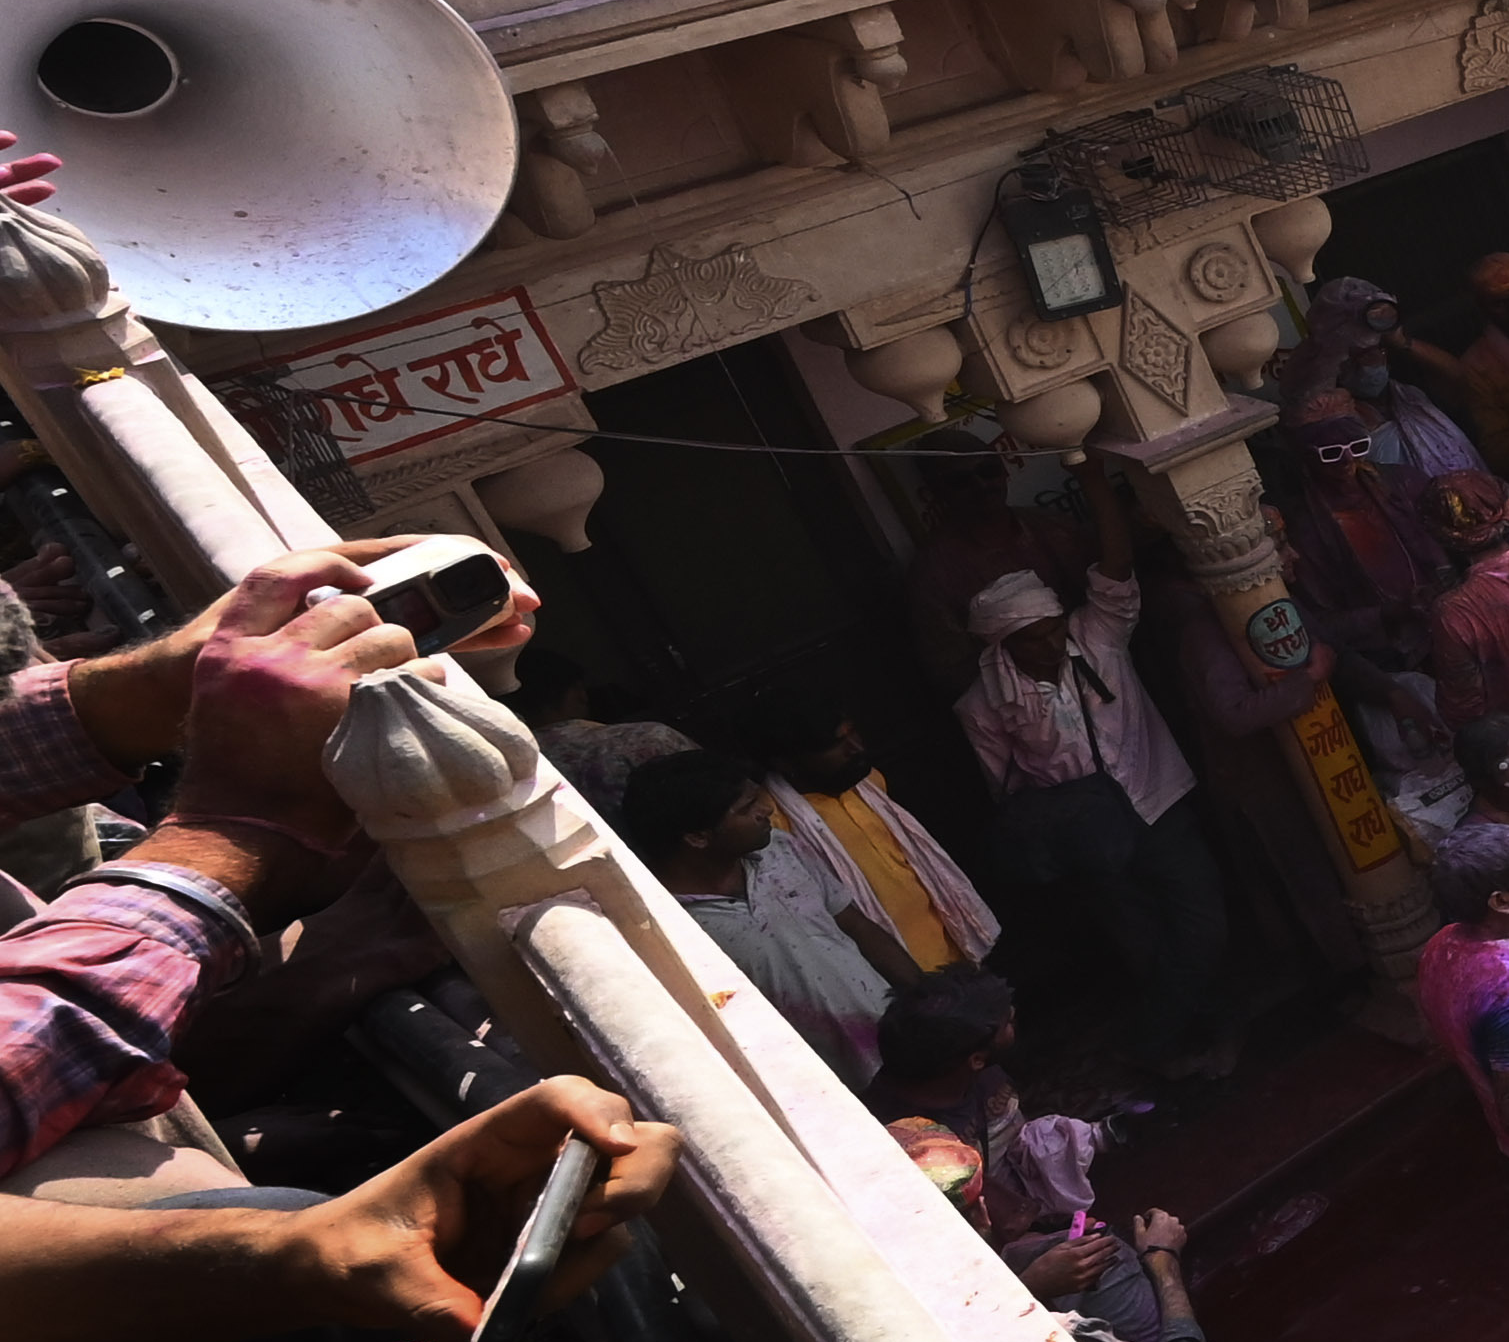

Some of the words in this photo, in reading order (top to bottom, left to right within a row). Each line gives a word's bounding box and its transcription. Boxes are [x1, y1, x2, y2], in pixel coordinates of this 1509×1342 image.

[407, 316, 531, 405] राधे
[1263, 605, 1290, 633] श्री
[1264, 625, 1308, 660] राधा
[1307, 709, 1351, 757] गोपी
[1330, 754, 1368, 804] राधे
[1348, 797, 1386, 848] राधे
